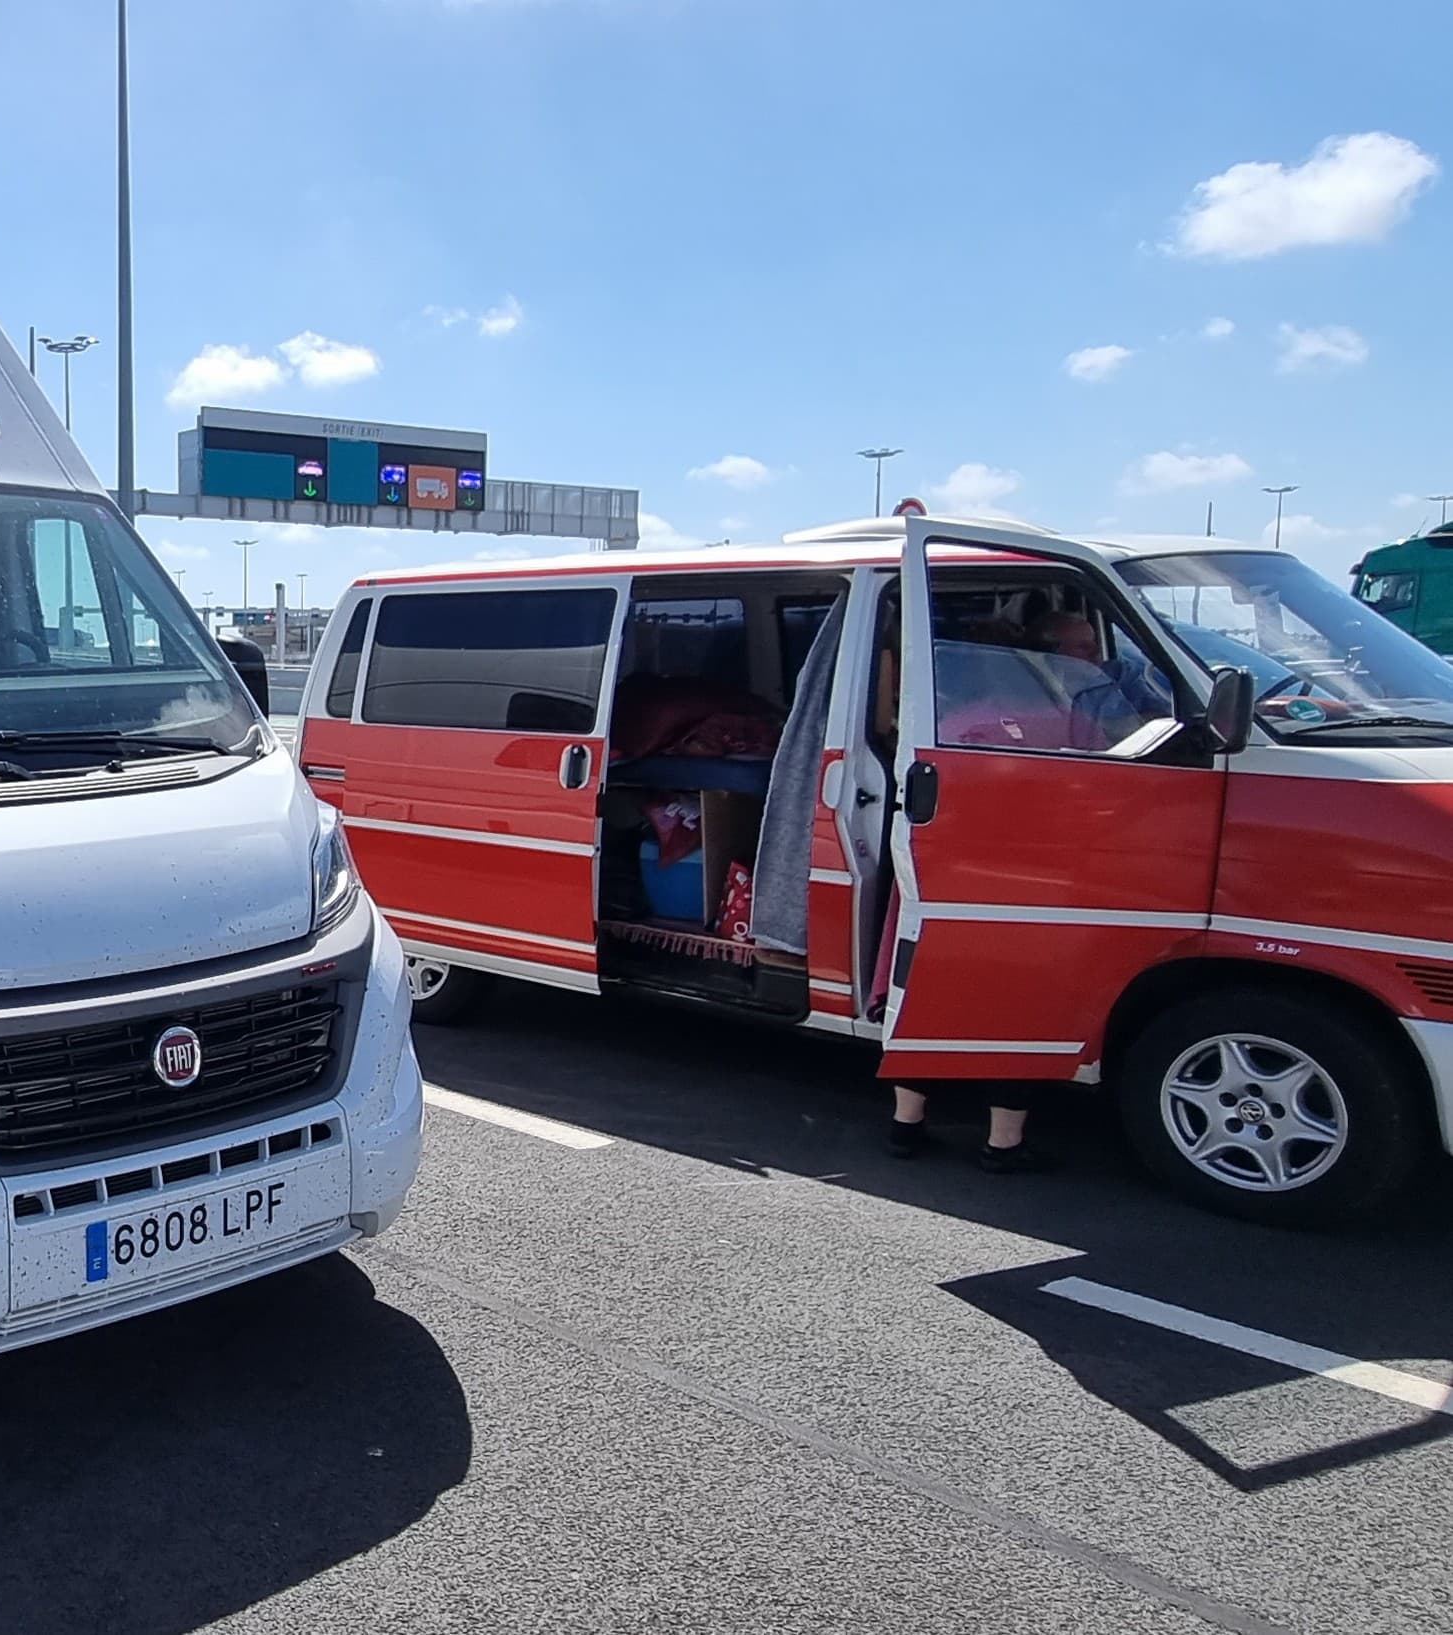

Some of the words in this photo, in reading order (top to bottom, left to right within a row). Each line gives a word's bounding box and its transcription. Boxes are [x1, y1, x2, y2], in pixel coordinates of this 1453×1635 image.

[322, 423, 355, 436] SORTIE
[1277, 944, 1301, 956] bar
[165, 1042, 192, 1073] FIAT
[114, 1203, 209, 1265] 6808
[223, 1182, 285, 1236] LPF
